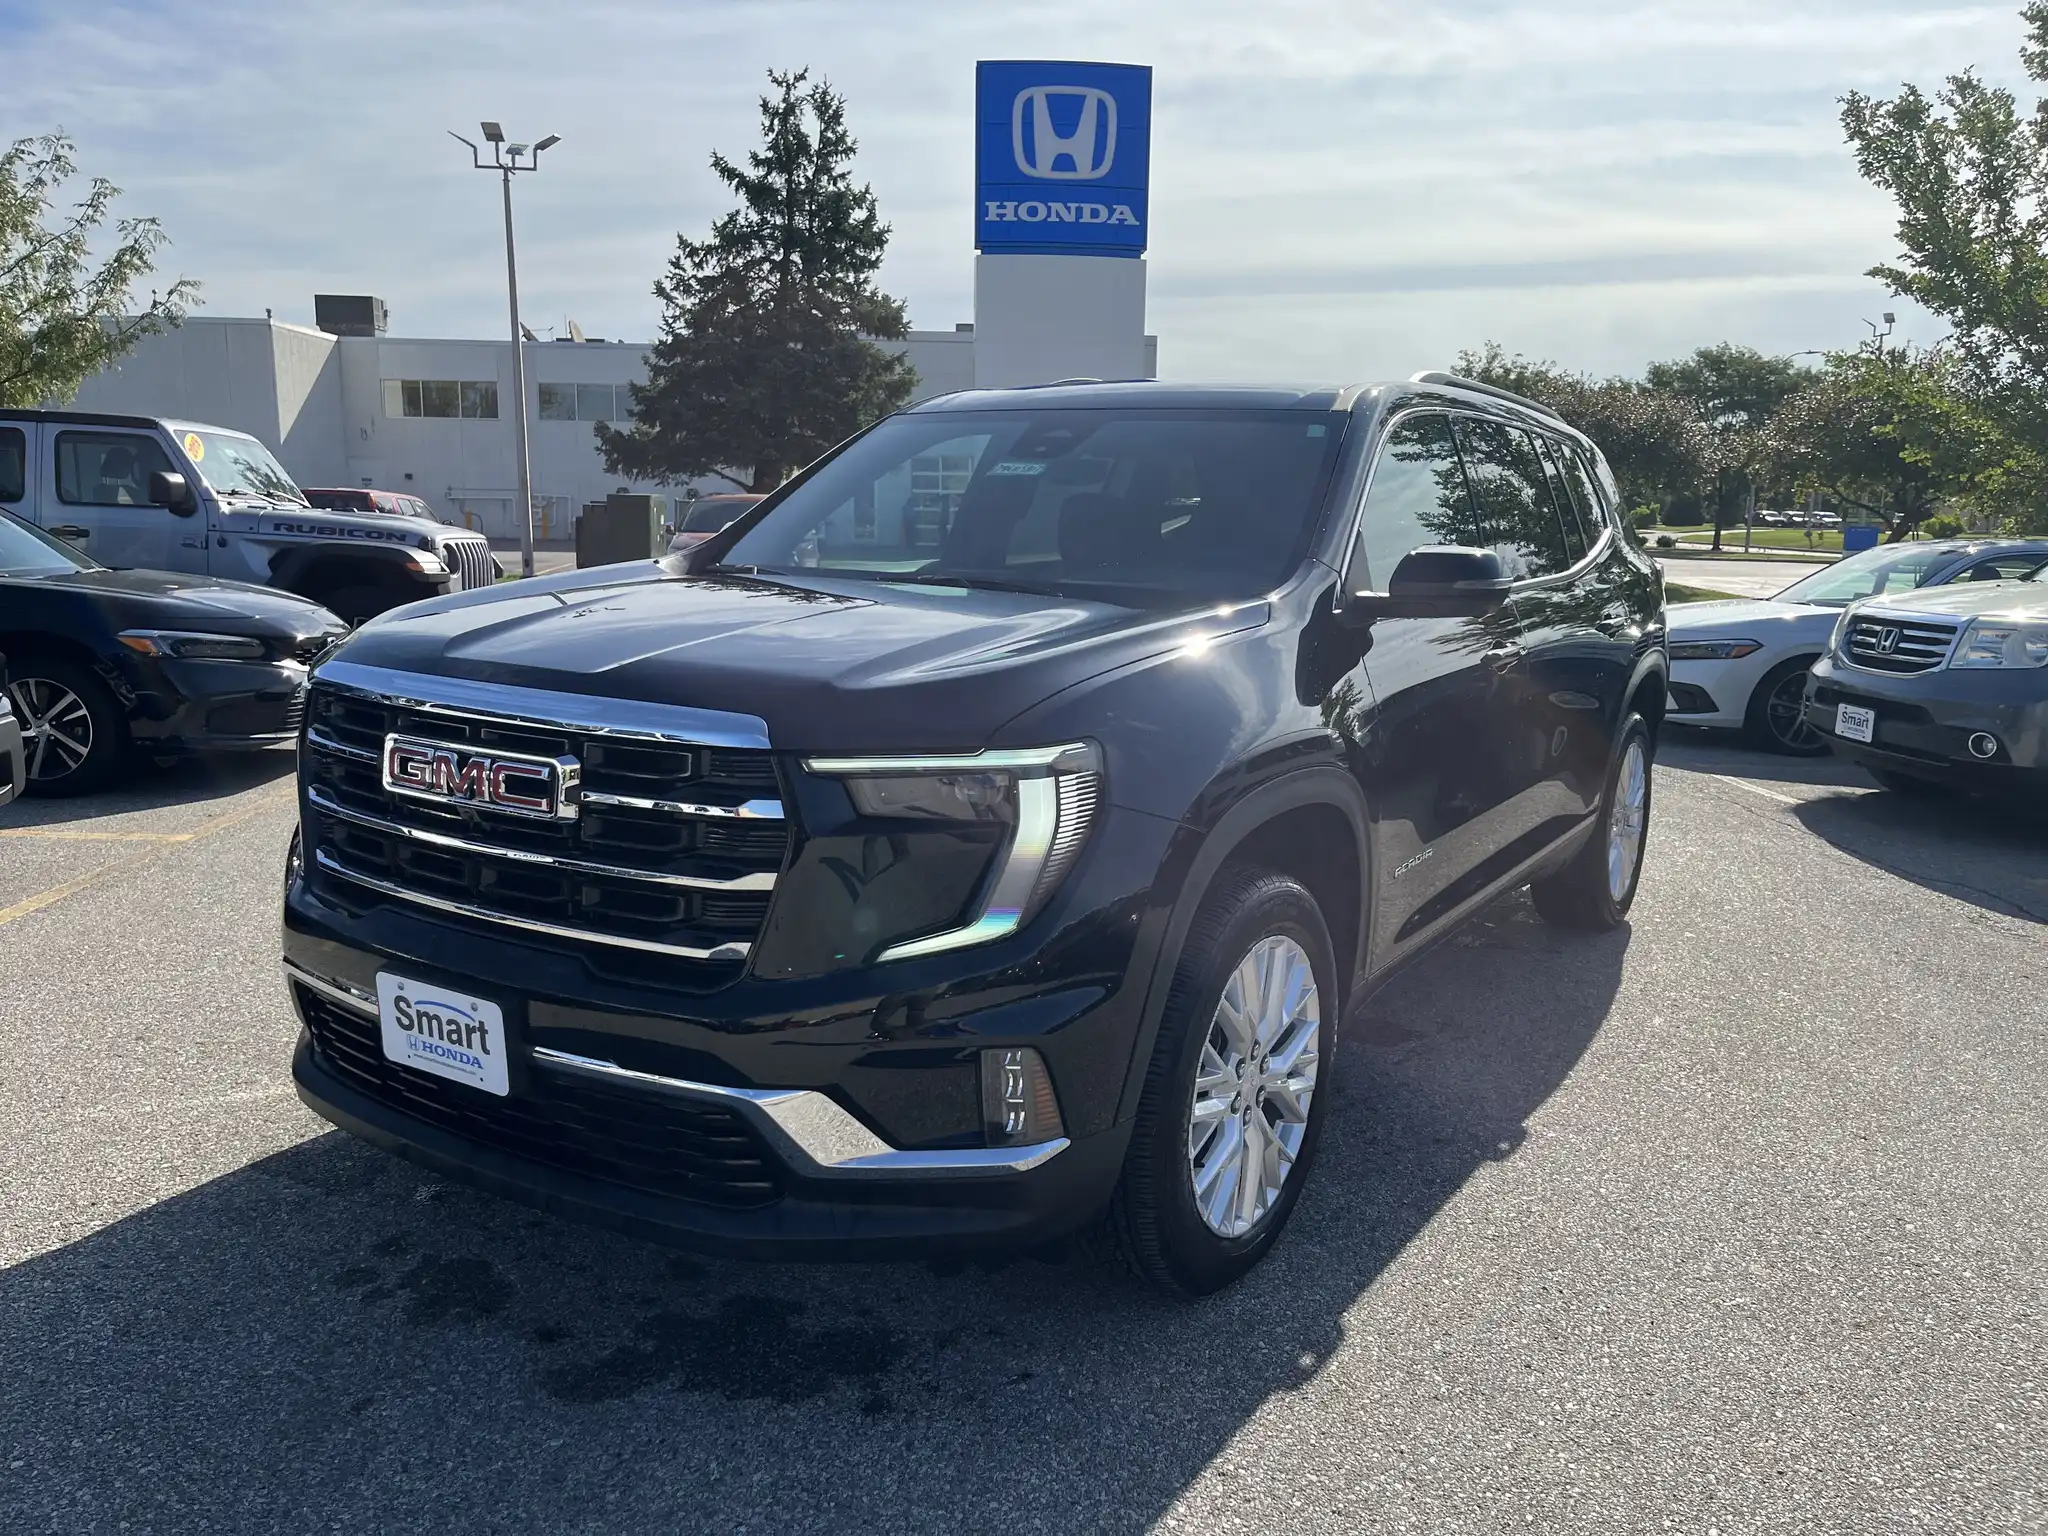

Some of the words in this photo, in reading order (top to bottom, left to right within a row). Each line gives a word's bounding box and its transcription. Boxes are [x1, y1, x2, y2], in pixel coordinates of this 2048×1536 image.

[984, 201, 1140, 226] HONDA
[273, 522, 407, 542] RUBICON
[1841, 711, 1869, 730] Smart
[388, 742, 551, 812] GMC
[1394, 848, 1433, 878] ACADIA
[393, 995, 491, 1056] Smart
[420, 1040, 484, 1070] HONDA
